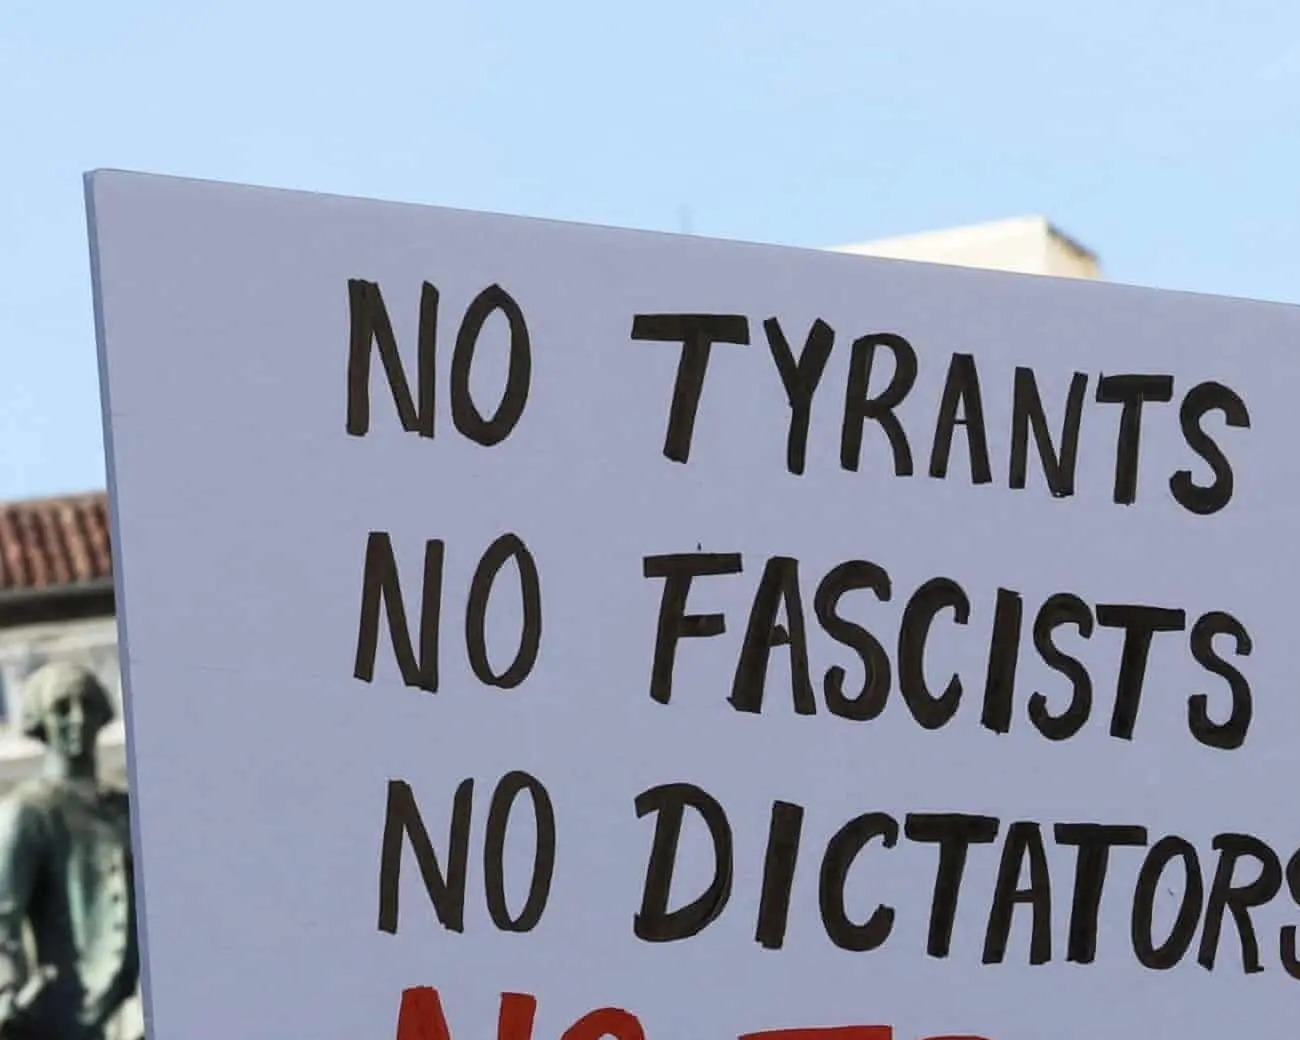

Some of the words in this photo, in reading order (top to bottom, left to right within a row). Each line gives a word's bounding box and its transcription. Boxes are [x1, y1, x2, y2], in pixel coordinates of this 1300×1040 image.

[346, 279, 532, 447] NO
[631, 313, 1251, 515] TYRANTS
[354, 531, 542, 693] NO
[643, 553, 1253, 750] FASCISTS
[378, 771, 556, 934] NO
